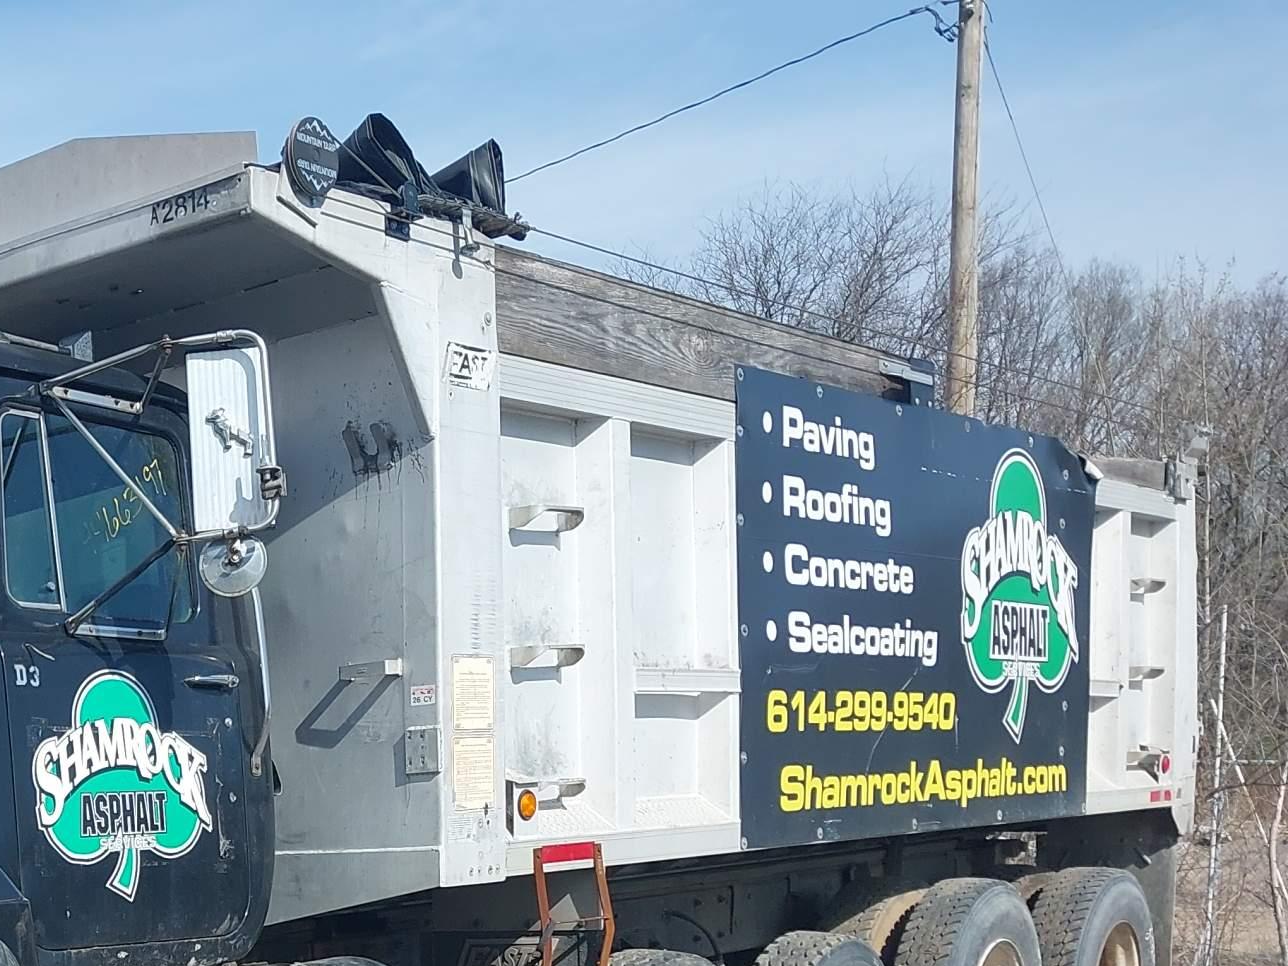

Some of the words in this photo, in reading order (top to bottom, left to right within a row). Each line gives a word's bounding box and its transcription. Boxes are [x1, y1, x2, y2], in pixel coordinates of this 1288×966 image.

[781, 404, 876, 471] Paving
[782, 474, 892, 537] Roofing
[784, 543, 914, 594] Concrete
[962, 510, 1079, 662] SHAMROCK
[787, 610, 939, 667] Sealcoating
[990, 601, 1050, 660] ASPHALT
[14, 664, 41, 687] D3
[1002, 661, 1040, 678] SERVICES
[412, 696, 421, 704] 26
[423, 695, 433, 703] CY
[766, 688, 957, 733] 614-299-9540
[32, 717, 213, 832] SHAMROCK
[779, 757, 1068, 813] ShamrockAsphalt.com
[80, 791, 168, 837] ASPHALT
[99, 834, 158, 851] SERVICES
